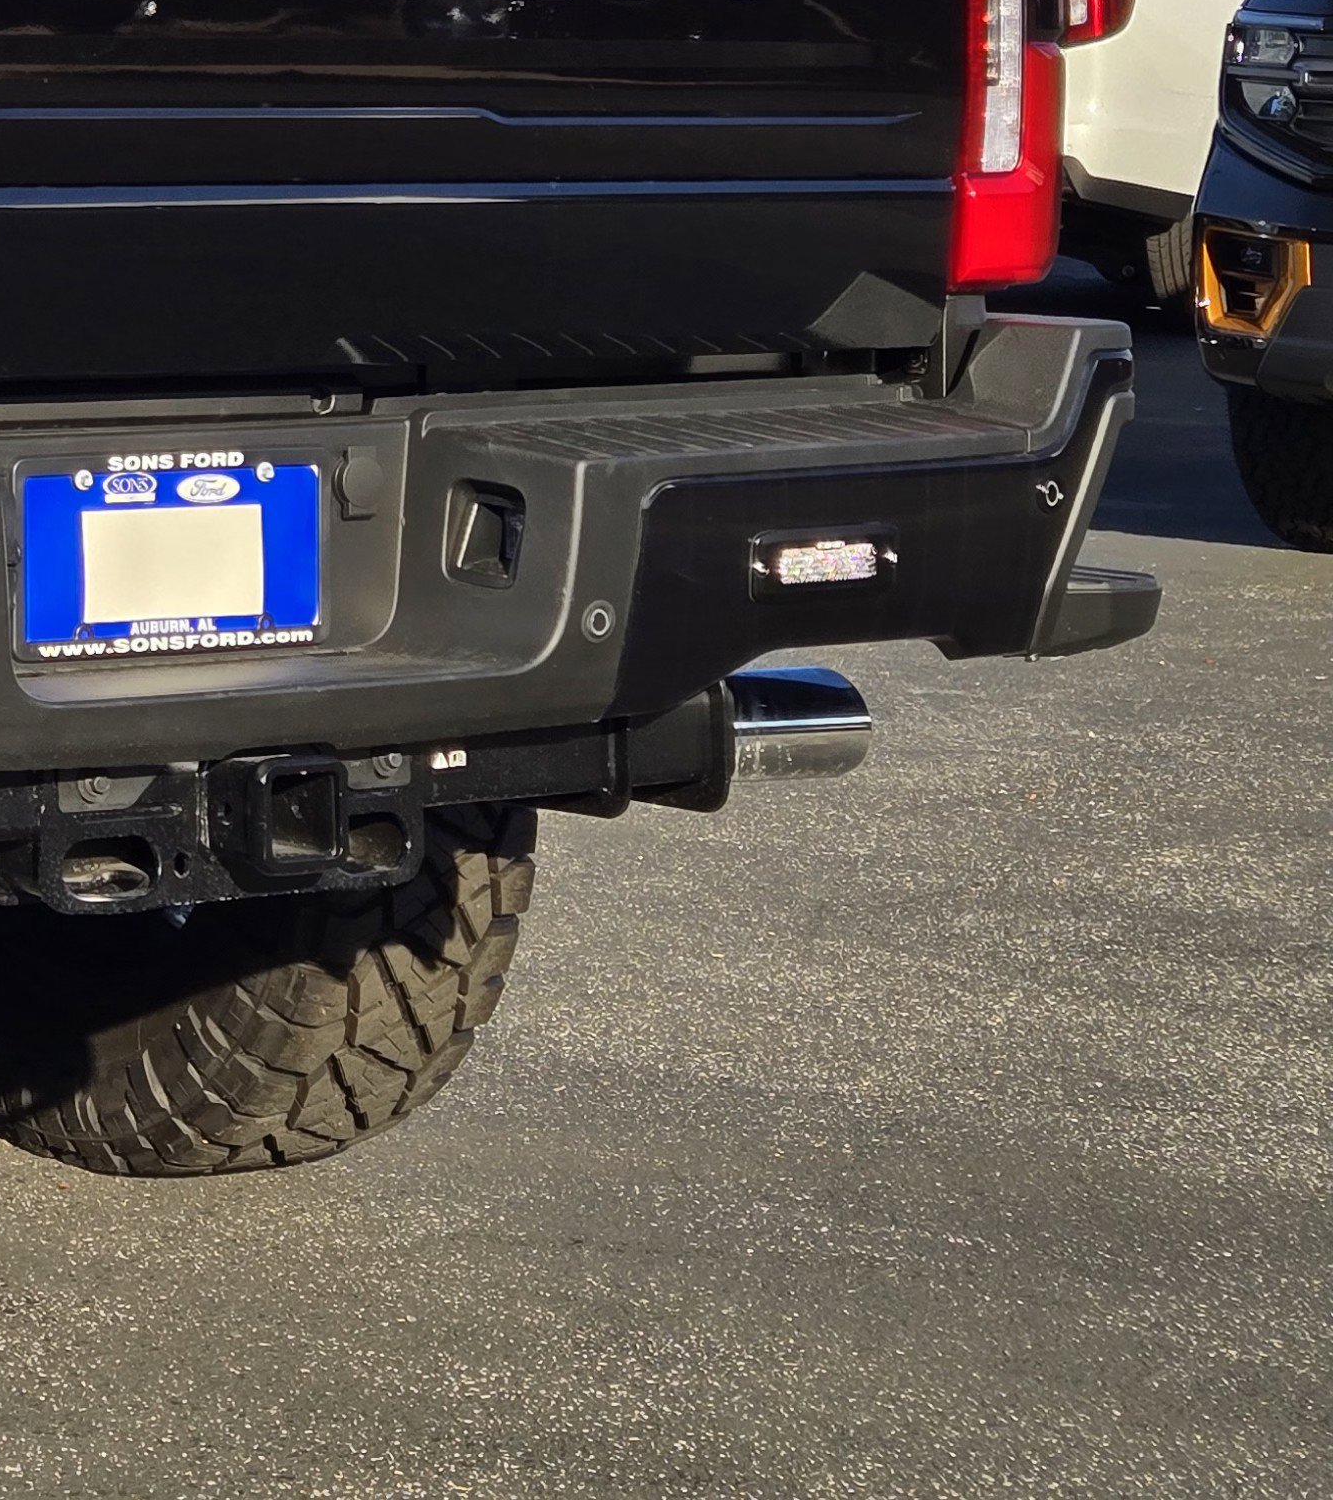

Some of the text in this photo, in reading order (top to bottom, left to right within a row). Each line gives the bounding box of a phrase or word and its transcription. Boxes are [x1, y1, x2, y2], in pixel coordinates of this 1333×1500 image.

[107, 451, 245, 472] SONS FORD
[111, 477, 149, 494] SONS
[189, 478, 227, 498] Ford
[129, 617, 217, 636] AUBURN, AL
[38, 628, 314, 658] www.SONSFORD.com
